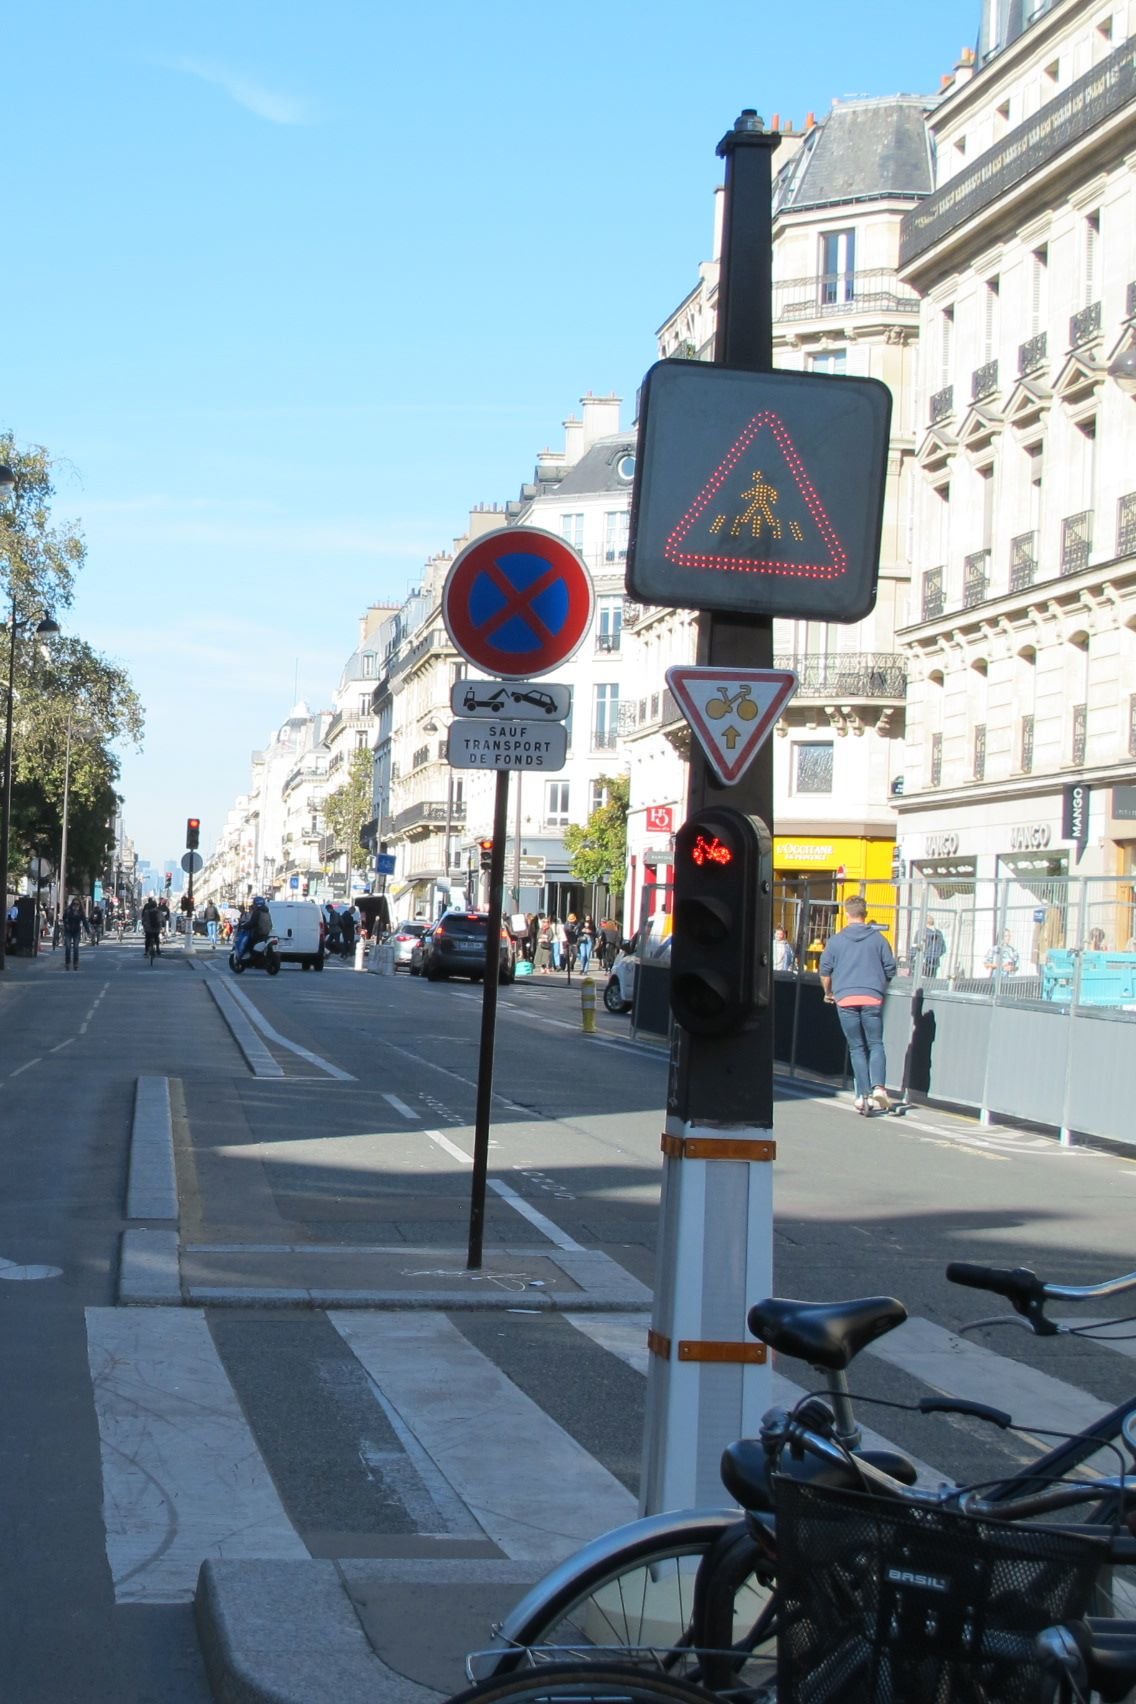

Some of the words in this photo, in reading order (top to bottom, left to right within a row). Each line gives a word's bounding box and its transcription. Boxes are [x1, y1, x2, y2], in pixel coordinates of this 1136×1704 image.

[488, 726, 527, 738] SAUF
[464, 739, 551, 753] TRANSPORT
[469, 753, 487, 764] DE
[494, 754, 544, 766] FONDS
[1071, 787, 1083, 837] MANGO
[888, 1569, 945, 1589] BASIL
